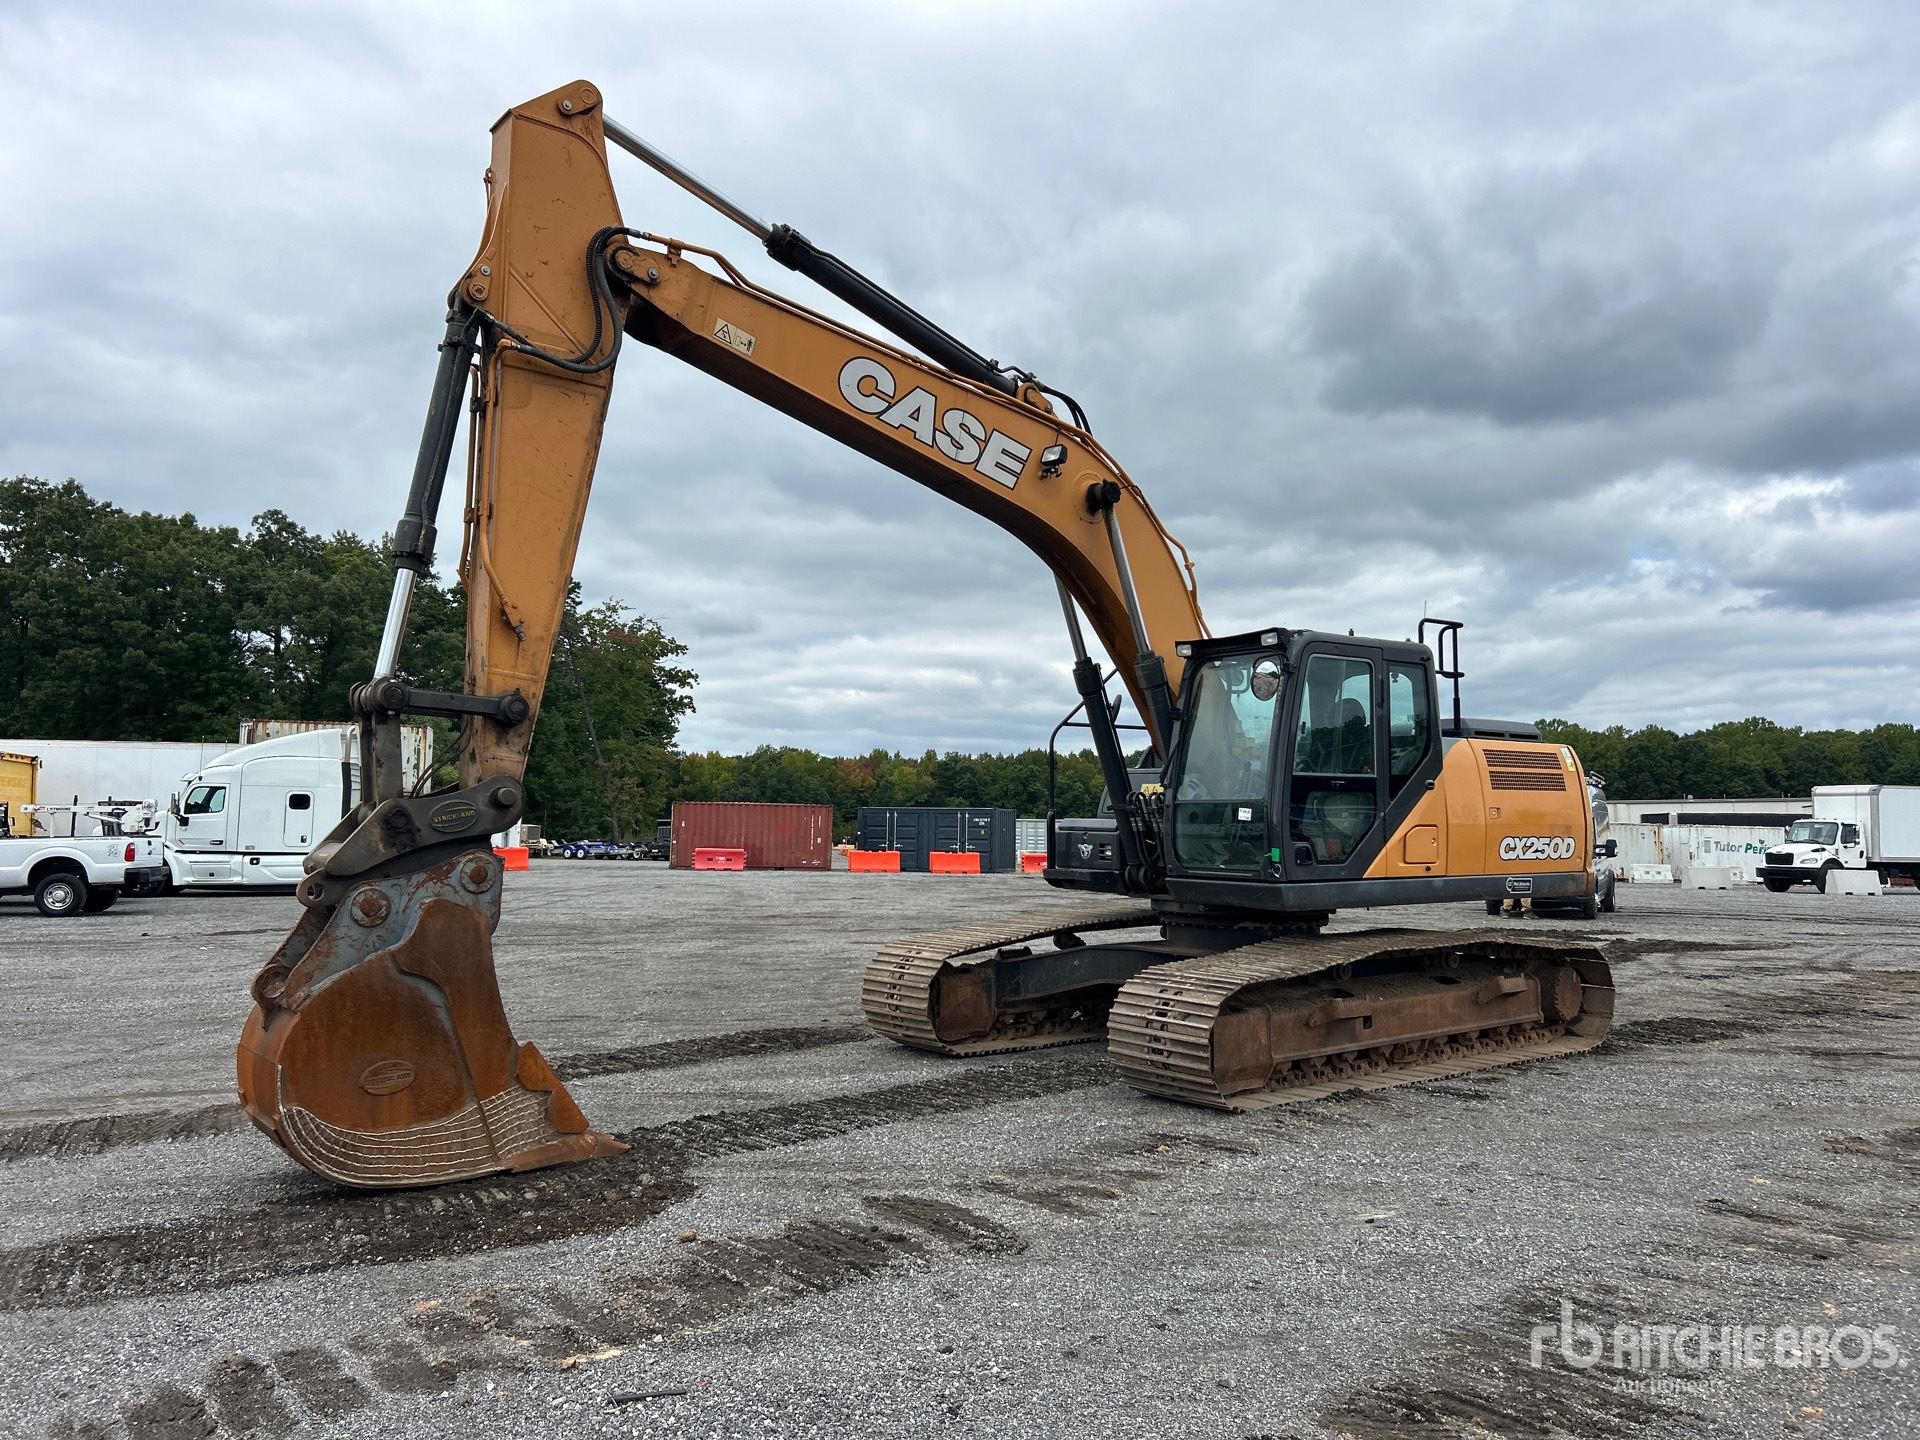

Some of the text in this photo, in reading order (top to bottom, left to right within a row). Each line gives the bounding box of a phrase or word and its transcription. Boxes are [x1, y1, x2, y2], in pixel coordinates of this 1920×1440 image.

[838, 356, 1033, 491] CASE
[433, 810, 475, 822] STRICKLAND
[1499, 836, 1575, 861] CX250D
[1714, 841, 1774, 854] Tutor Peri
